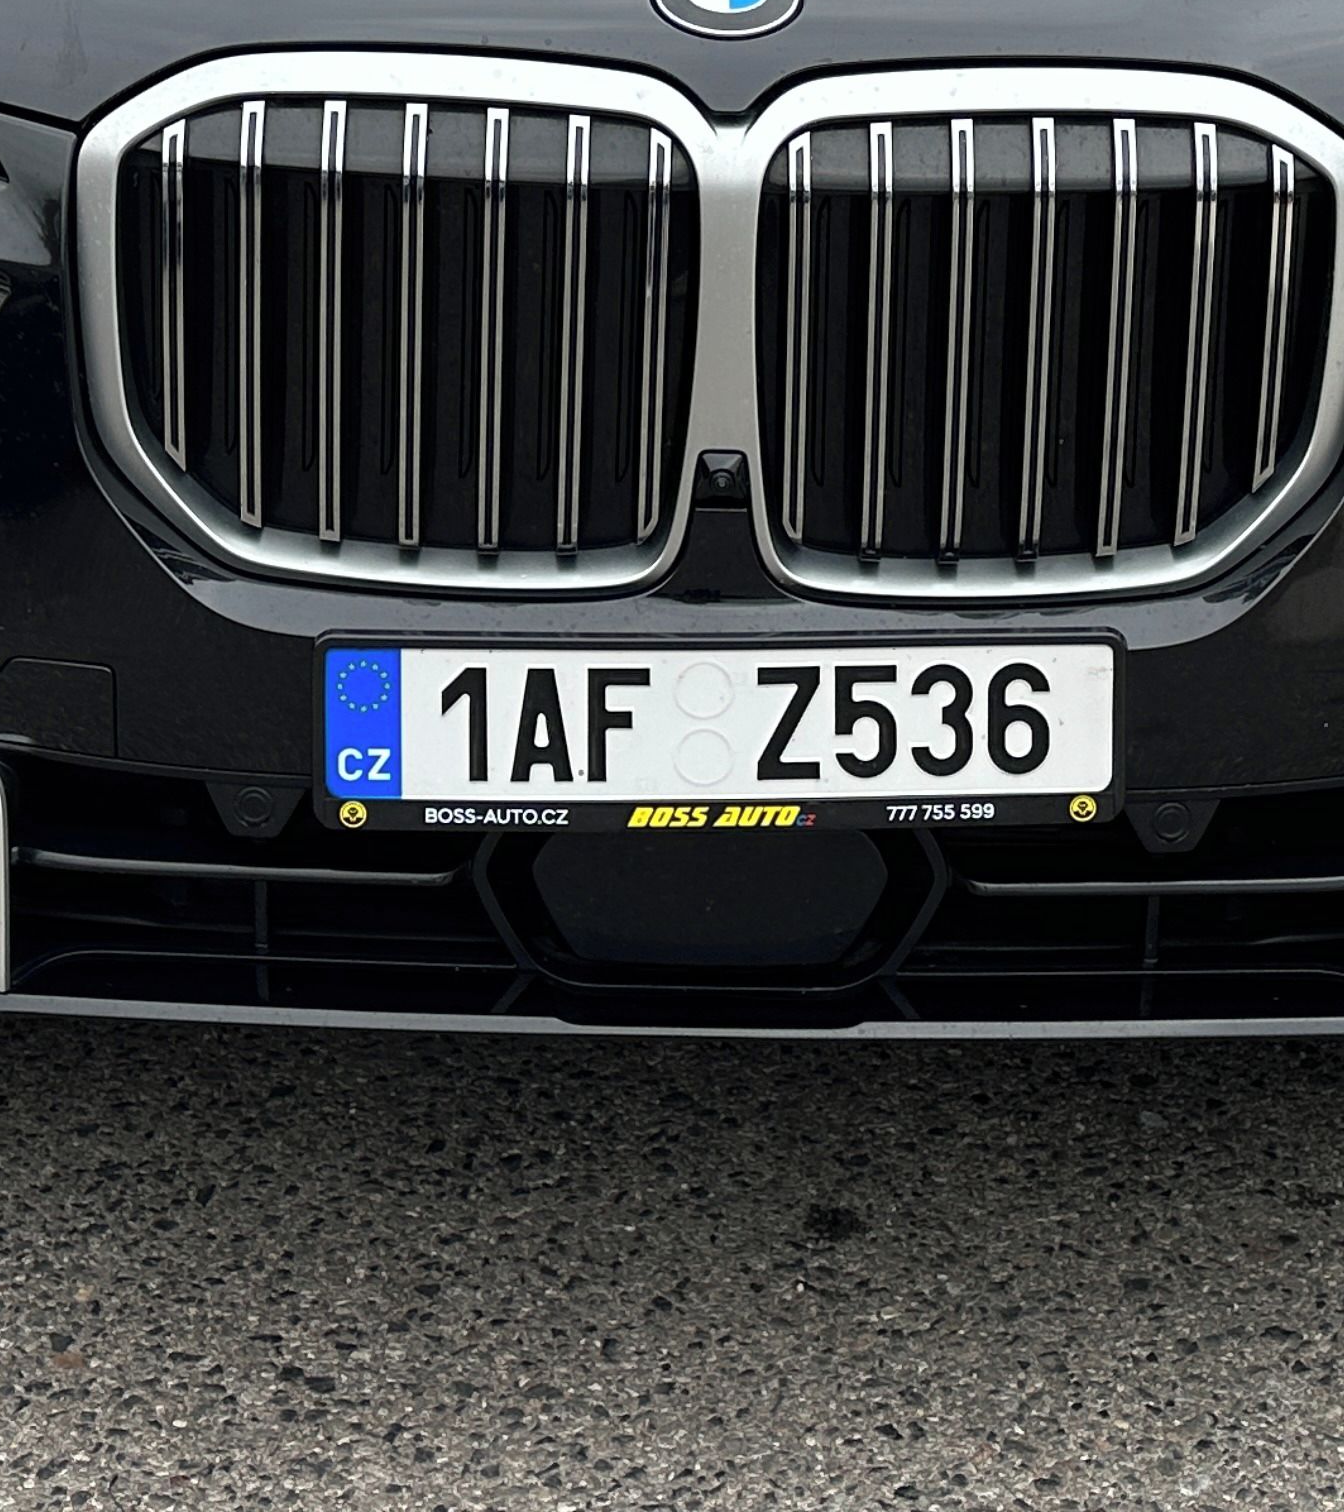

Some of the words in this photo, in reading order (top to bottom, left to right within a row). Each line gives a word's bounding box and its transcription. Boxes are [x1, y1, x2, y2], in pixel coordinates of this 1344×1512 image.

[337, 747, 392, 781] CZ
[441, 667, 651, 782] 1AF
[757, 662, 1051, 779] Z536
[424, 807, 569, 825] BOSS-AUTO.CZ
[627, 806, 709, 828] BOSS
[712, 805, 801, 827] AUTO
[886, 805, 918, 822] 777
[921, 804, 955, 821] 755
[959, 803, 995, 820] 599
